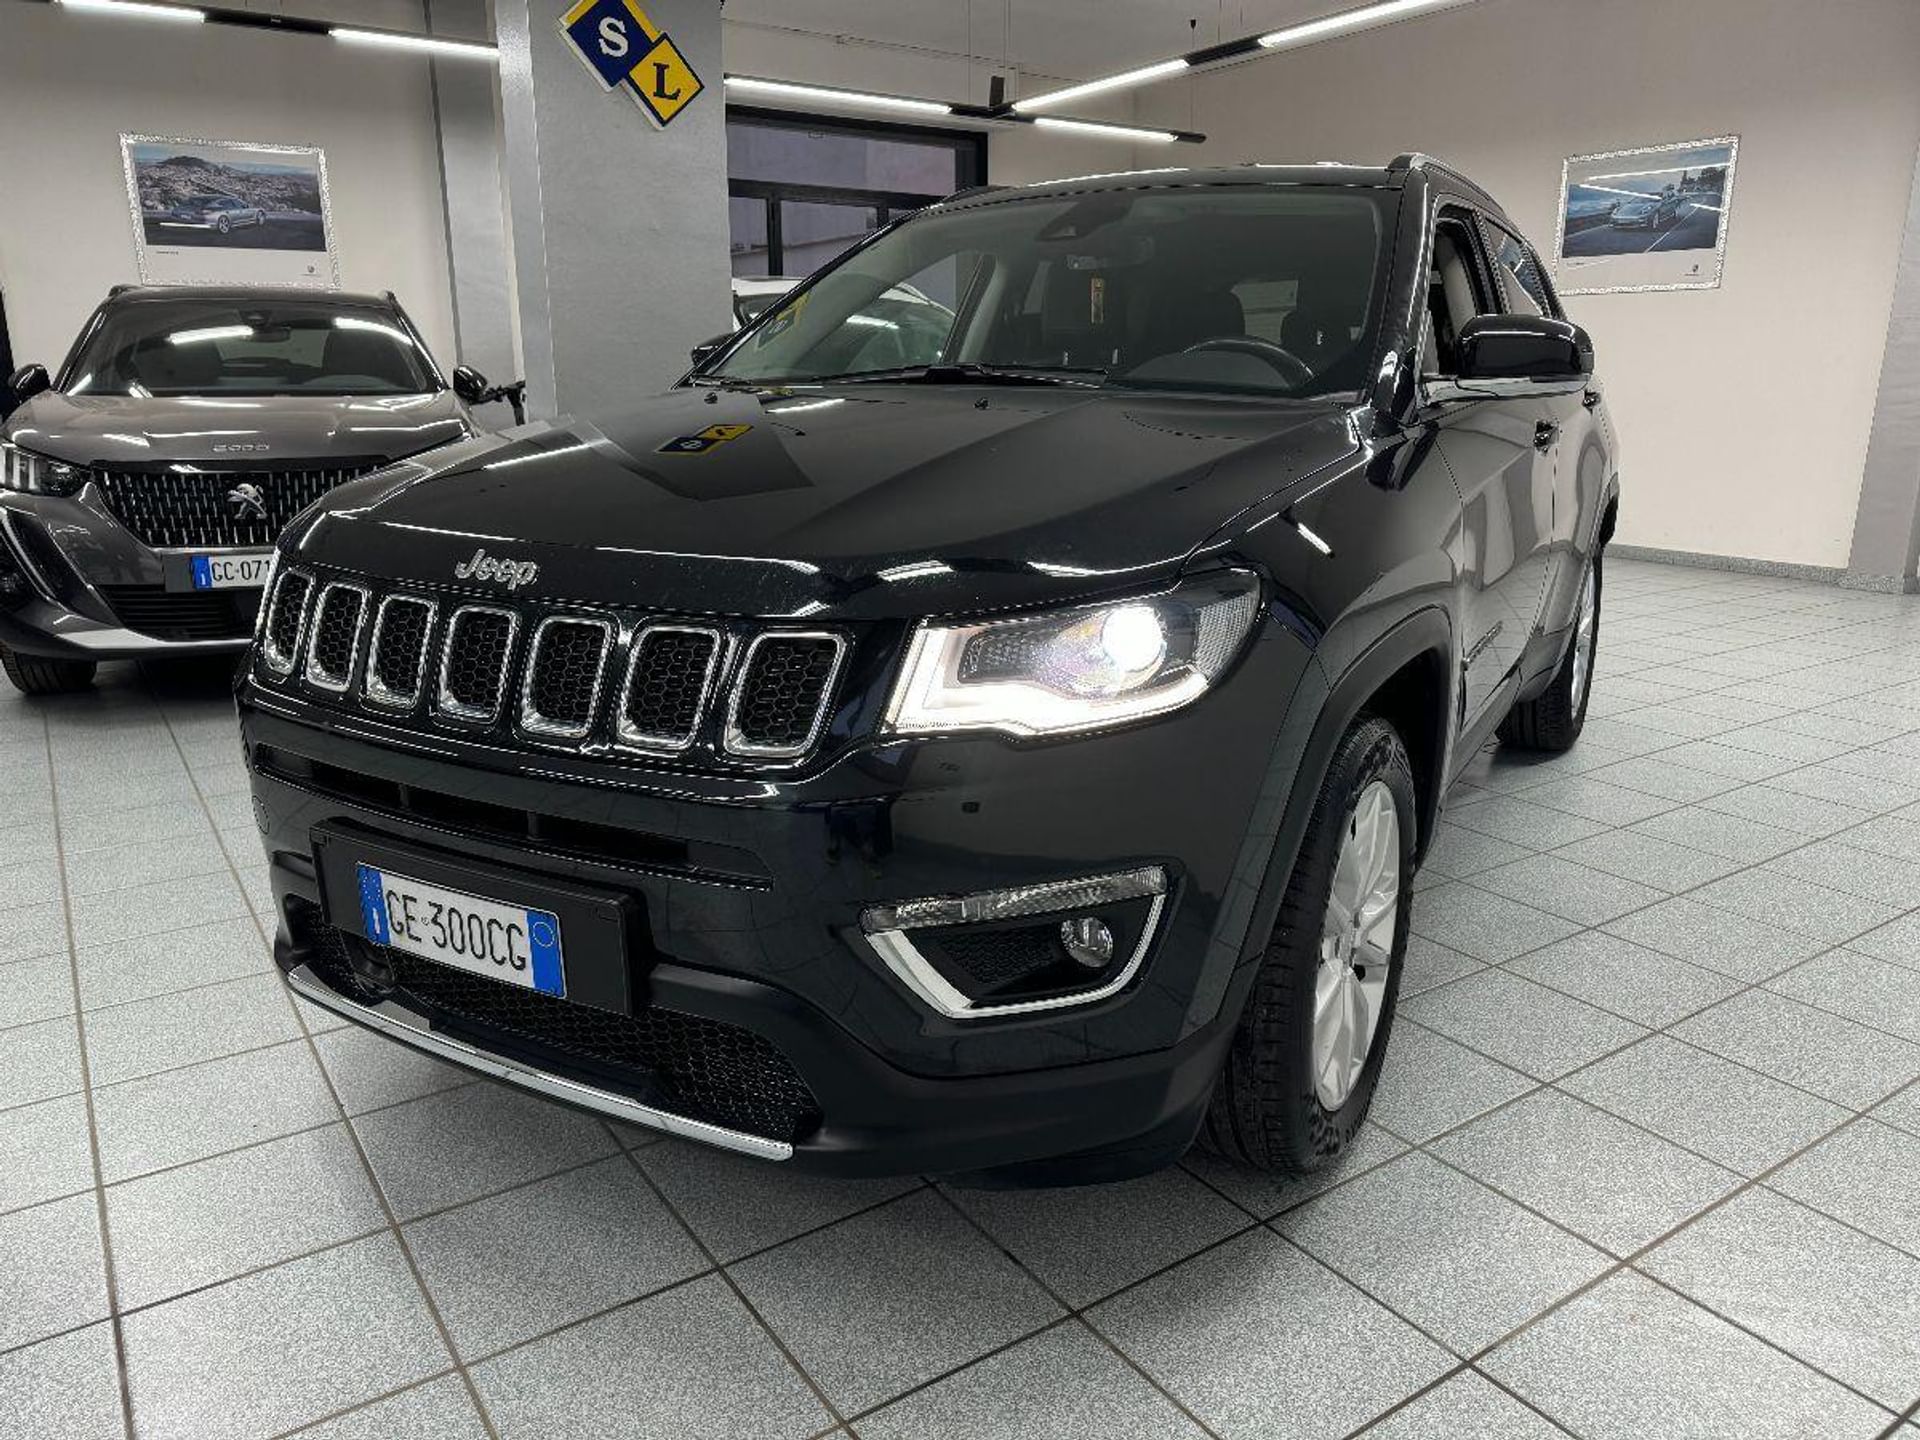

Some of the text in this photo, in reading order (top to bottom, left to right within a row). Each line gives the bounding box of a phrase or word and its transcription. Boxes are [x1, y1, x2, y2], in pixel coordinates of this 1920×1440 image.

[598, 16, 629, 57] S
[653, 62, 681, 100] L
[455, 548, 537, 591] Jeep
